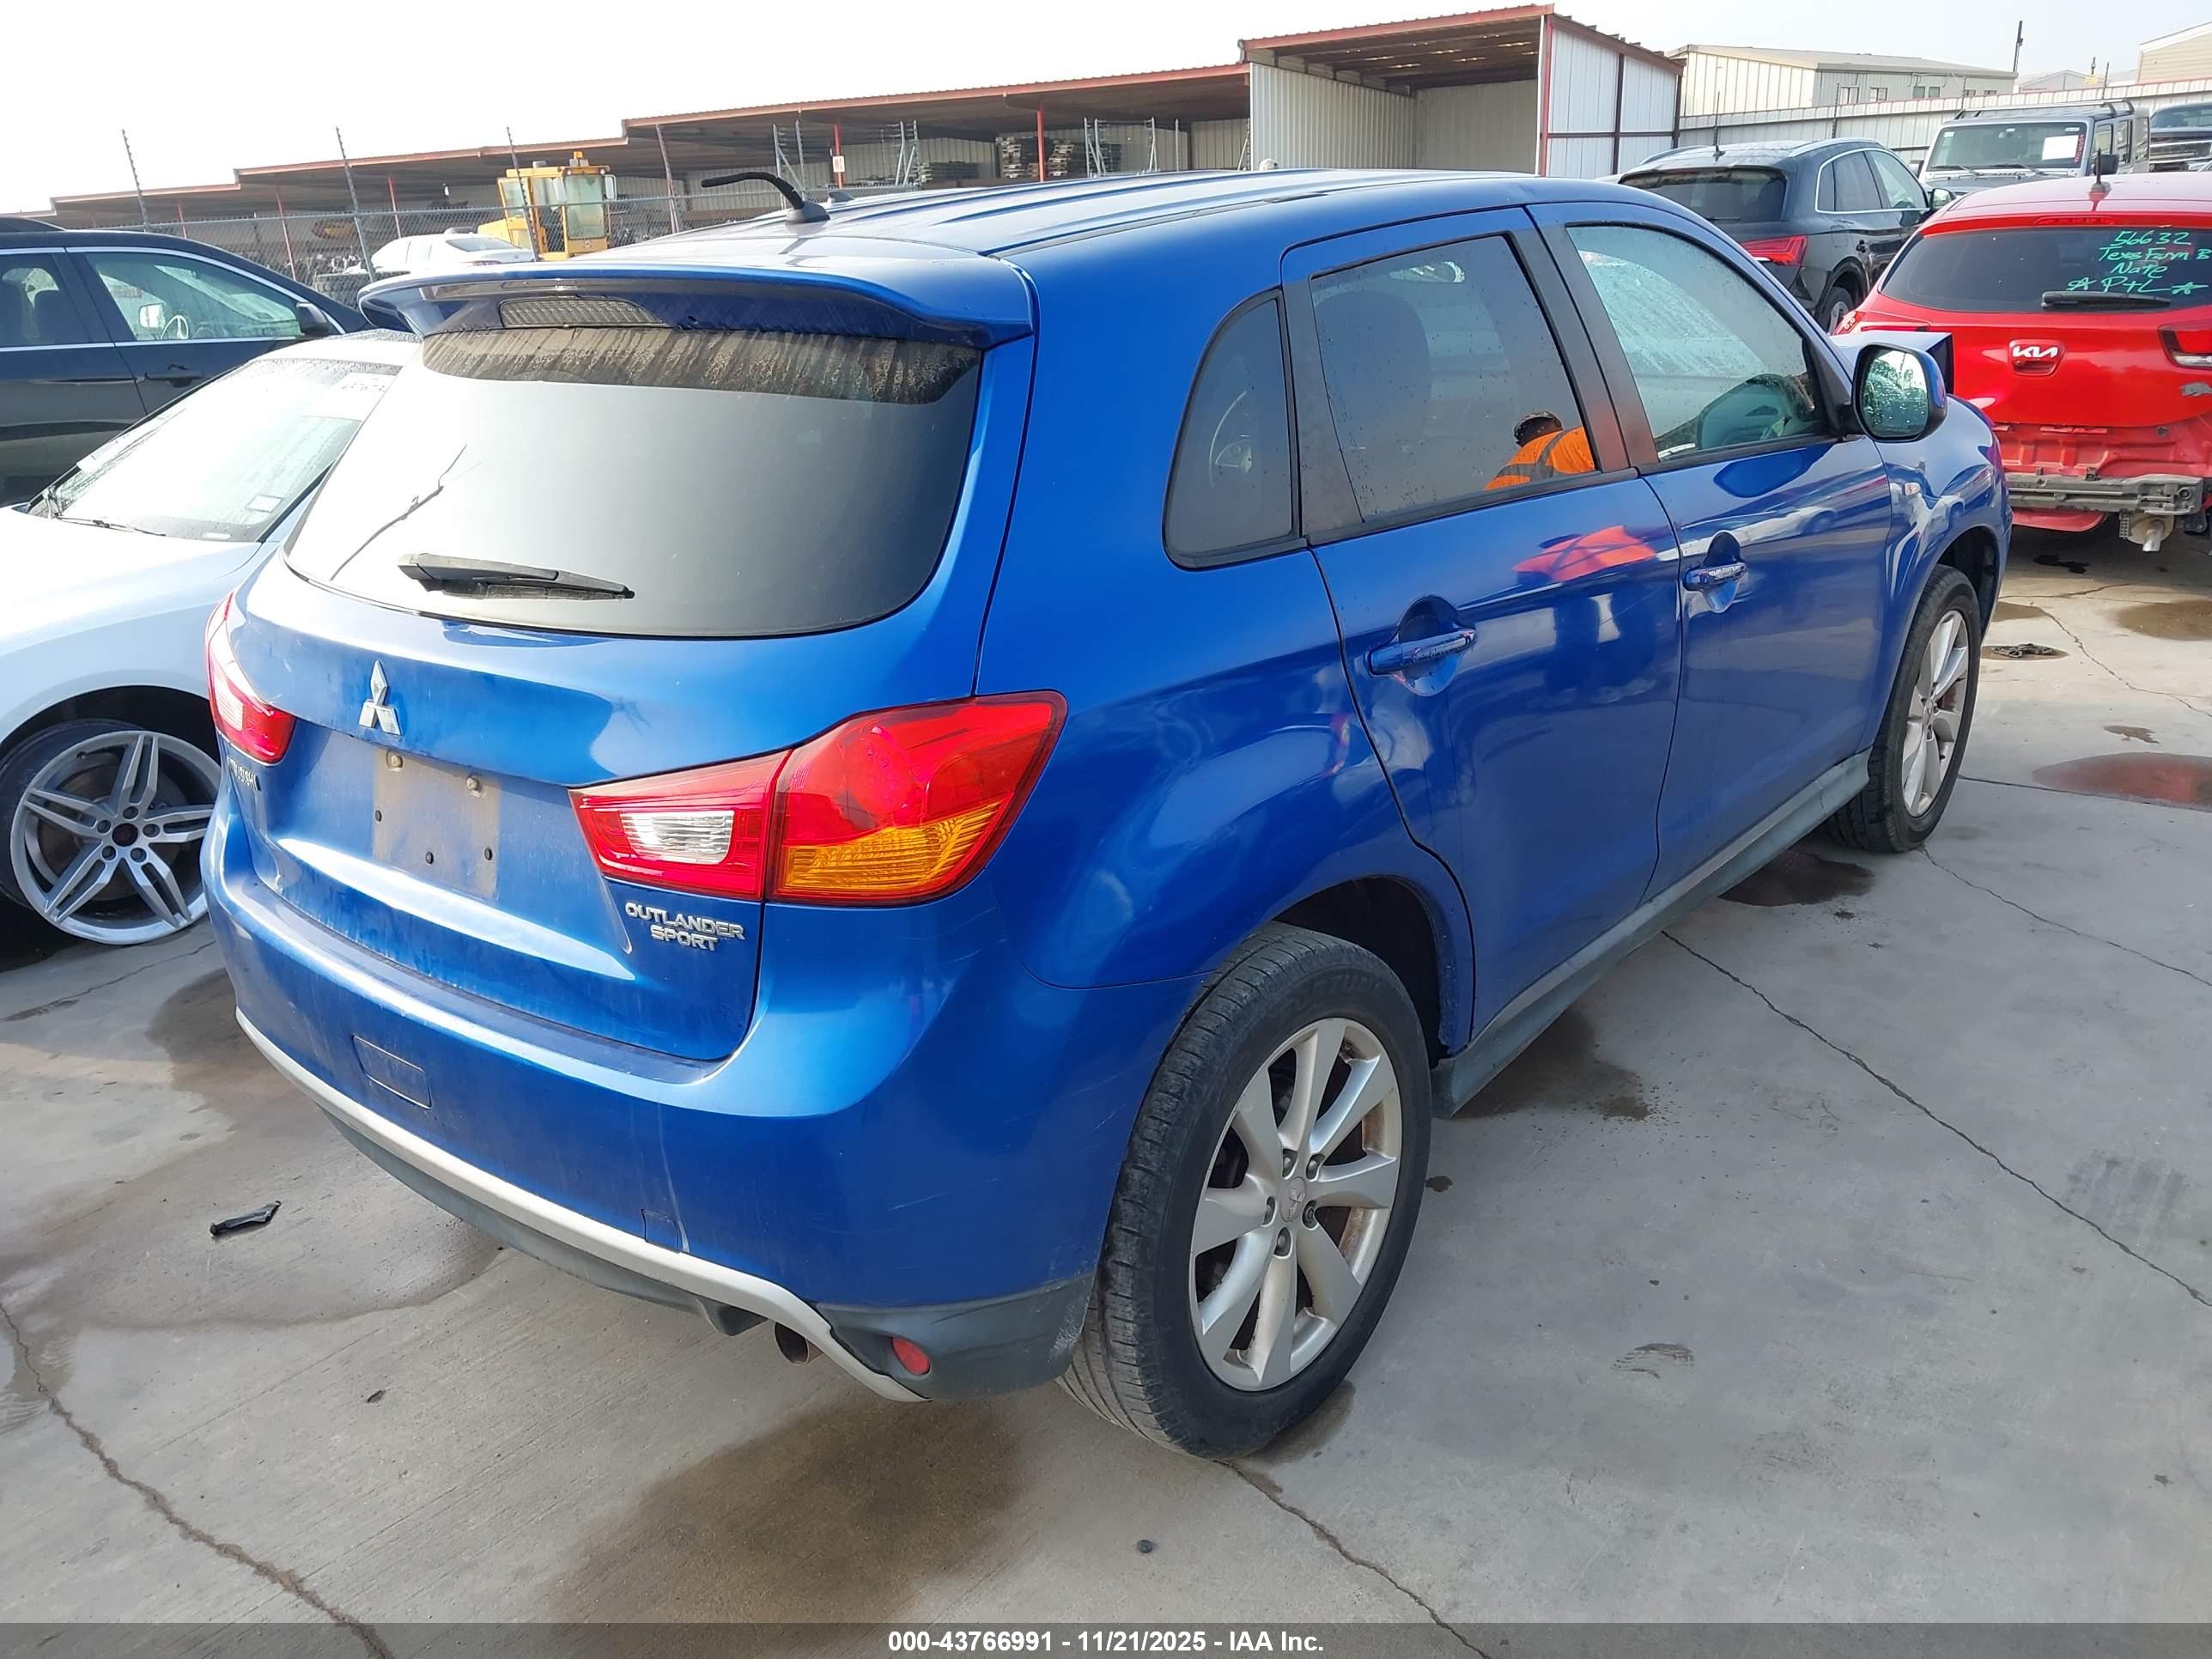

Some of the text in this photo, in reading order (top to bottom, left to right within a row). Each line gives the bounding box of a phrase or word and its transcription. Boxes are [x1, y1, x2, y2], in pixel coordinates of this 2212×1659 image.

[2110, 230, 2191, 246] 56632
[2012, 345, 2058, 358] KIA
[624, 902, 745, 940] OUTLANDER
[650, 924, 718, 951] SPORT
